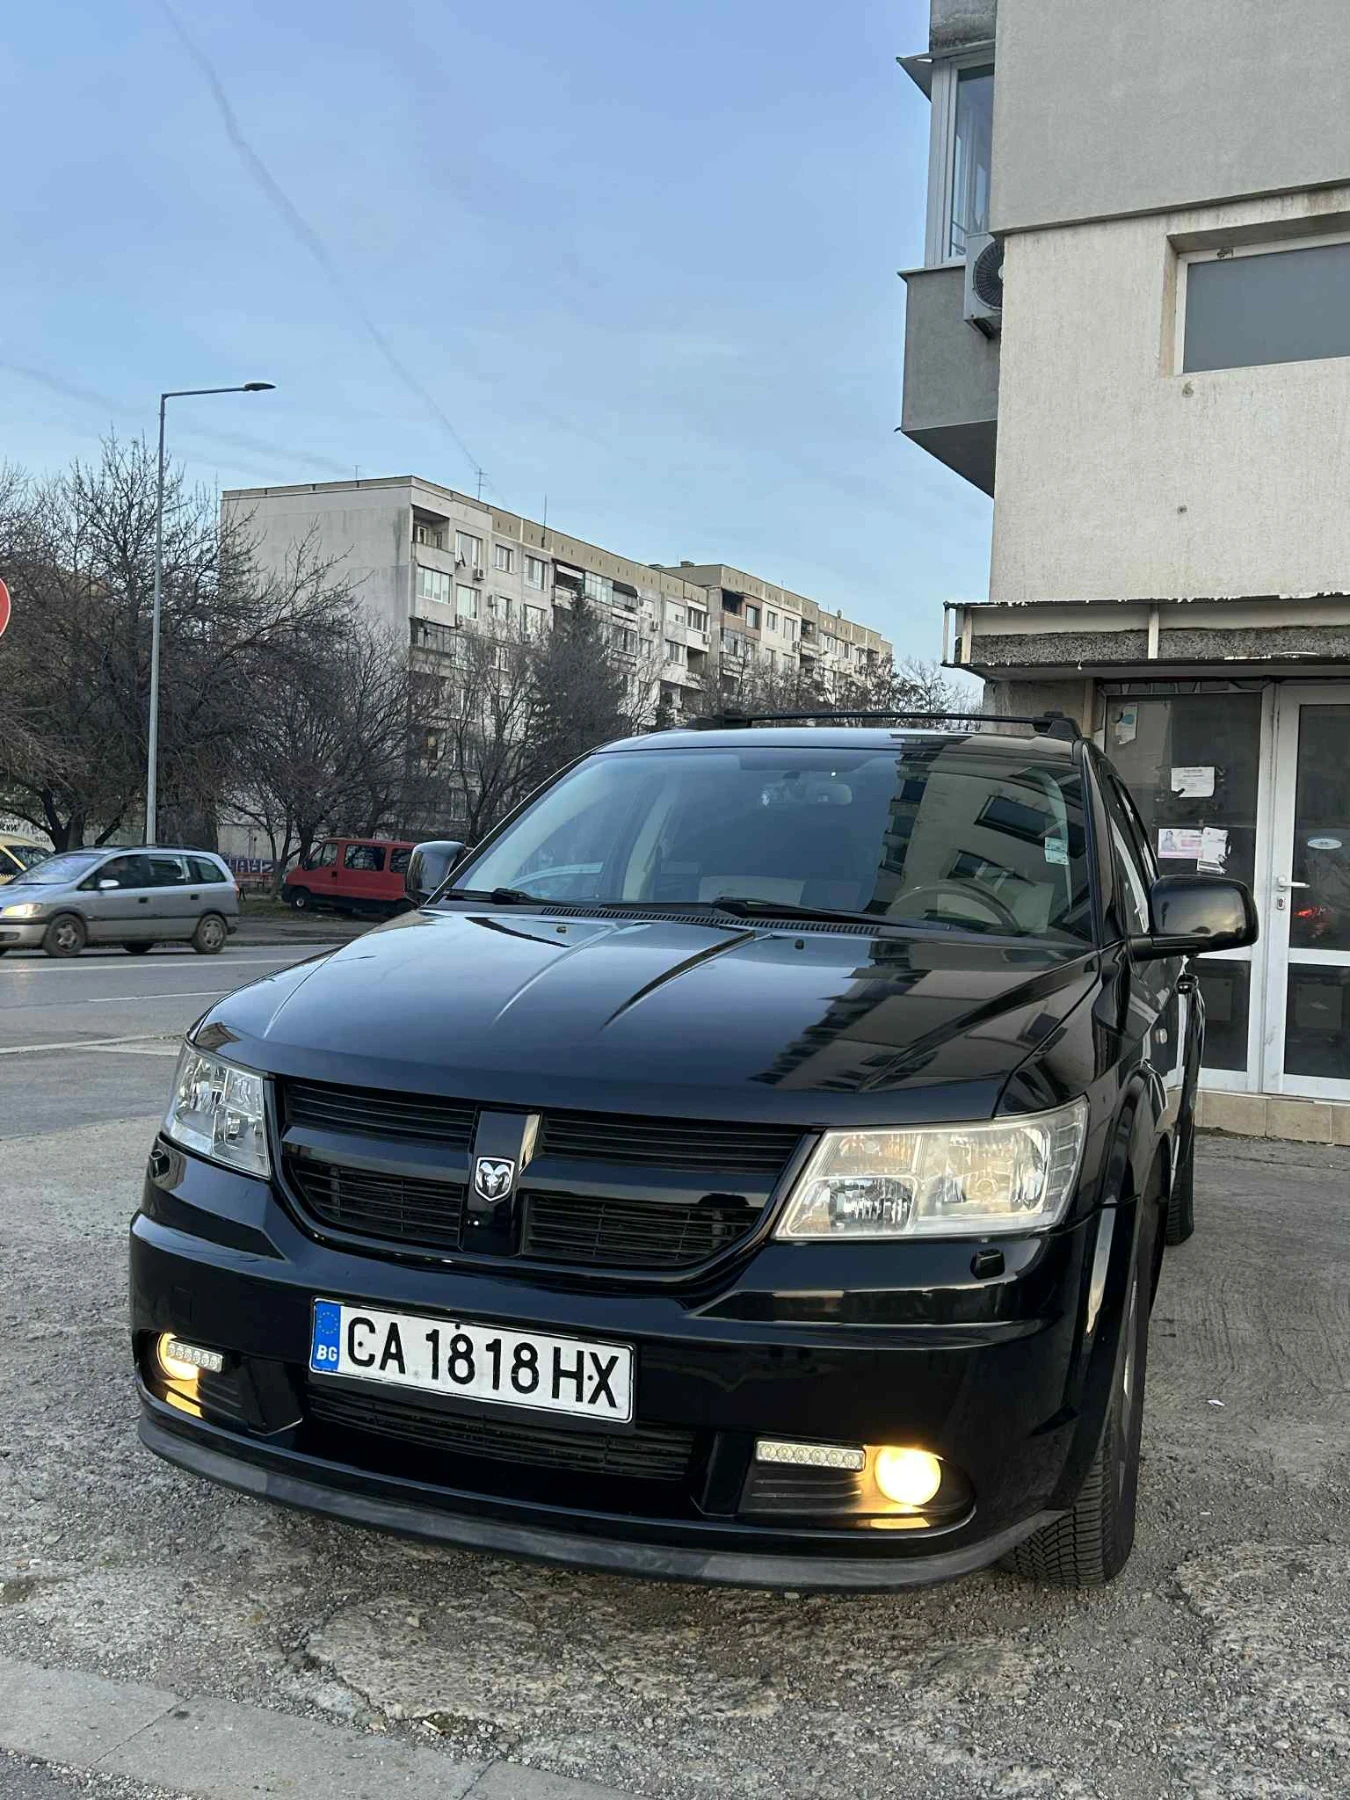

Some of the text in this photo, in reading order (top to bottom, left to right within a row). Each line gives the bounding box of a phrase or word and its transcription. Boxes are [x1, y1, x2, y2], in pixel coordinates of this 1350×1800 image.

[316, 1344, 338, 1362] BG
[348, 1317, 619, 1408] CA 1818 HX
